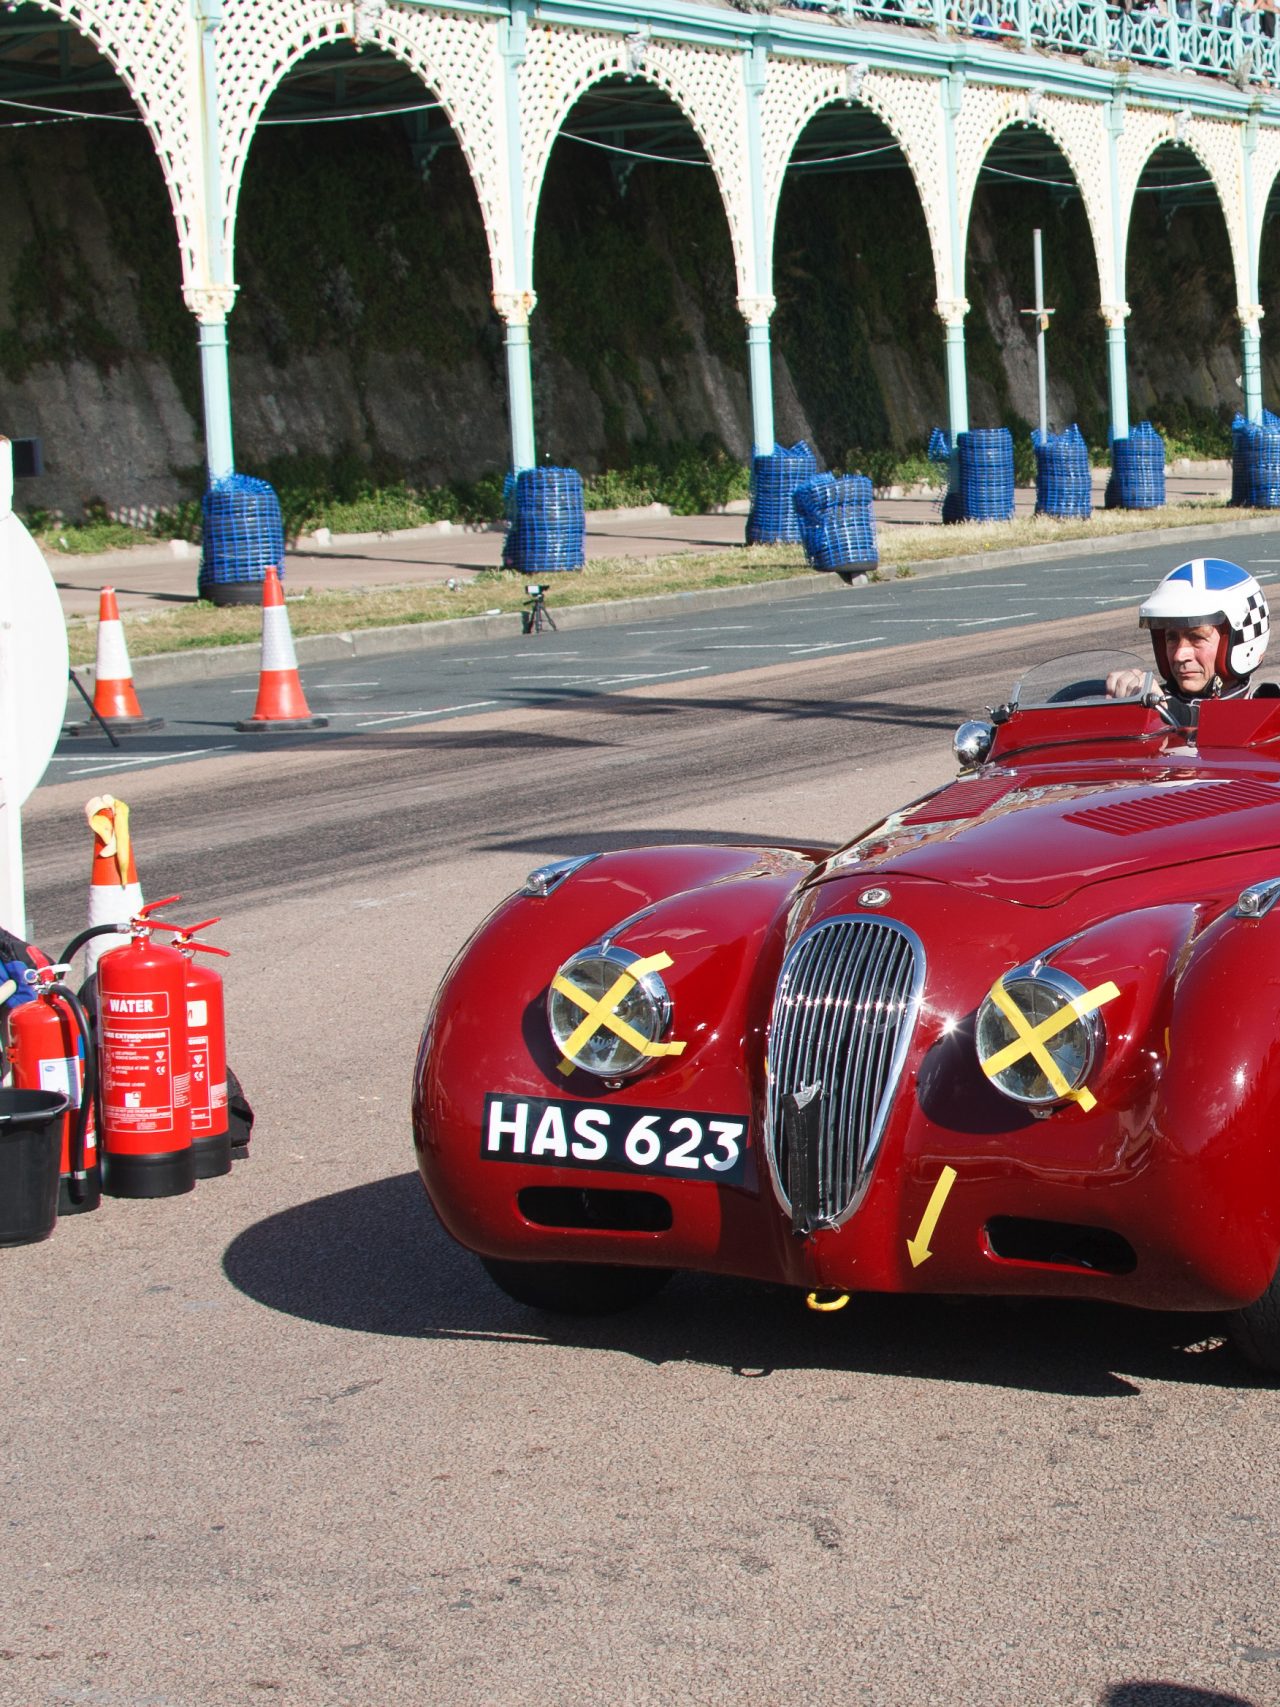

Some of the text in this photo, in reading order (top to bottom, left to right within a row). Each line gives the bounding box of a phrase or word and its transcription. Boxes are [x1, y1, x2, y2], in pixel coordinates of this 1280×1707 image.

[110, 999, 153, 1013] WATER
[488, 1101, 744, 1171] HAS 623
